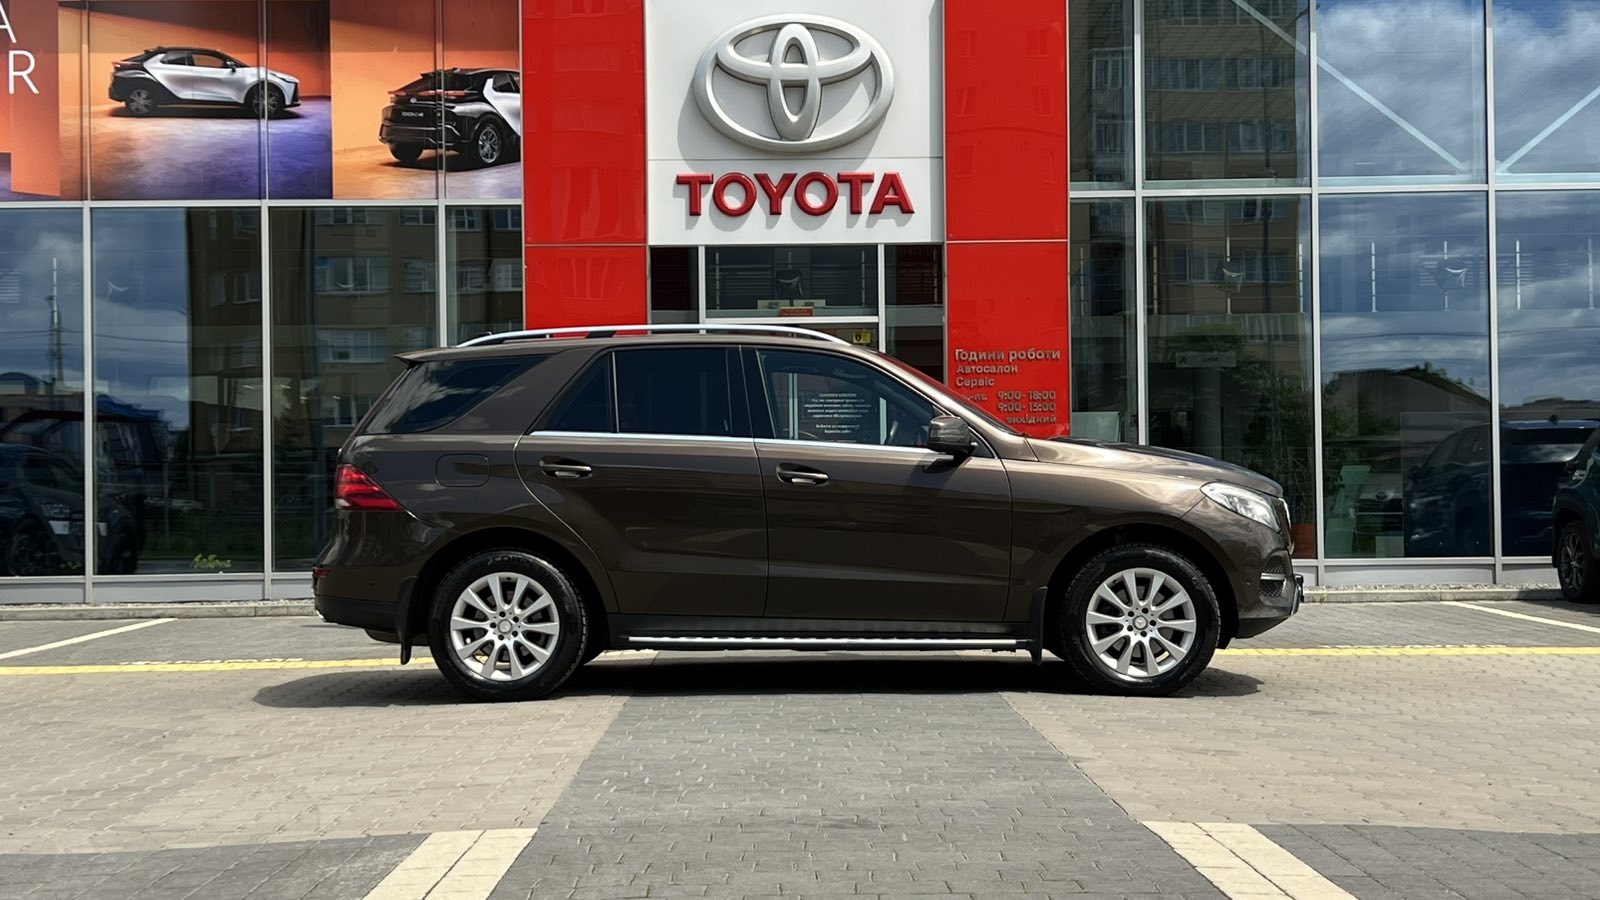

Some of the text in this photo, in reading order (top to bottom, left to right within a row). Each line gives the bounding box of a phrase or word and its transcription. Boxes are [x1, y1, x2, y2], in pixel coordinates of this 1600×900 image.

[676, 171, 915, 217] TOYOTA
[955, 348, 1060, 362] Години роботи
[956, 364, 1018, 374] Автосалон
[955, 377, 995, 388] Сервіс
